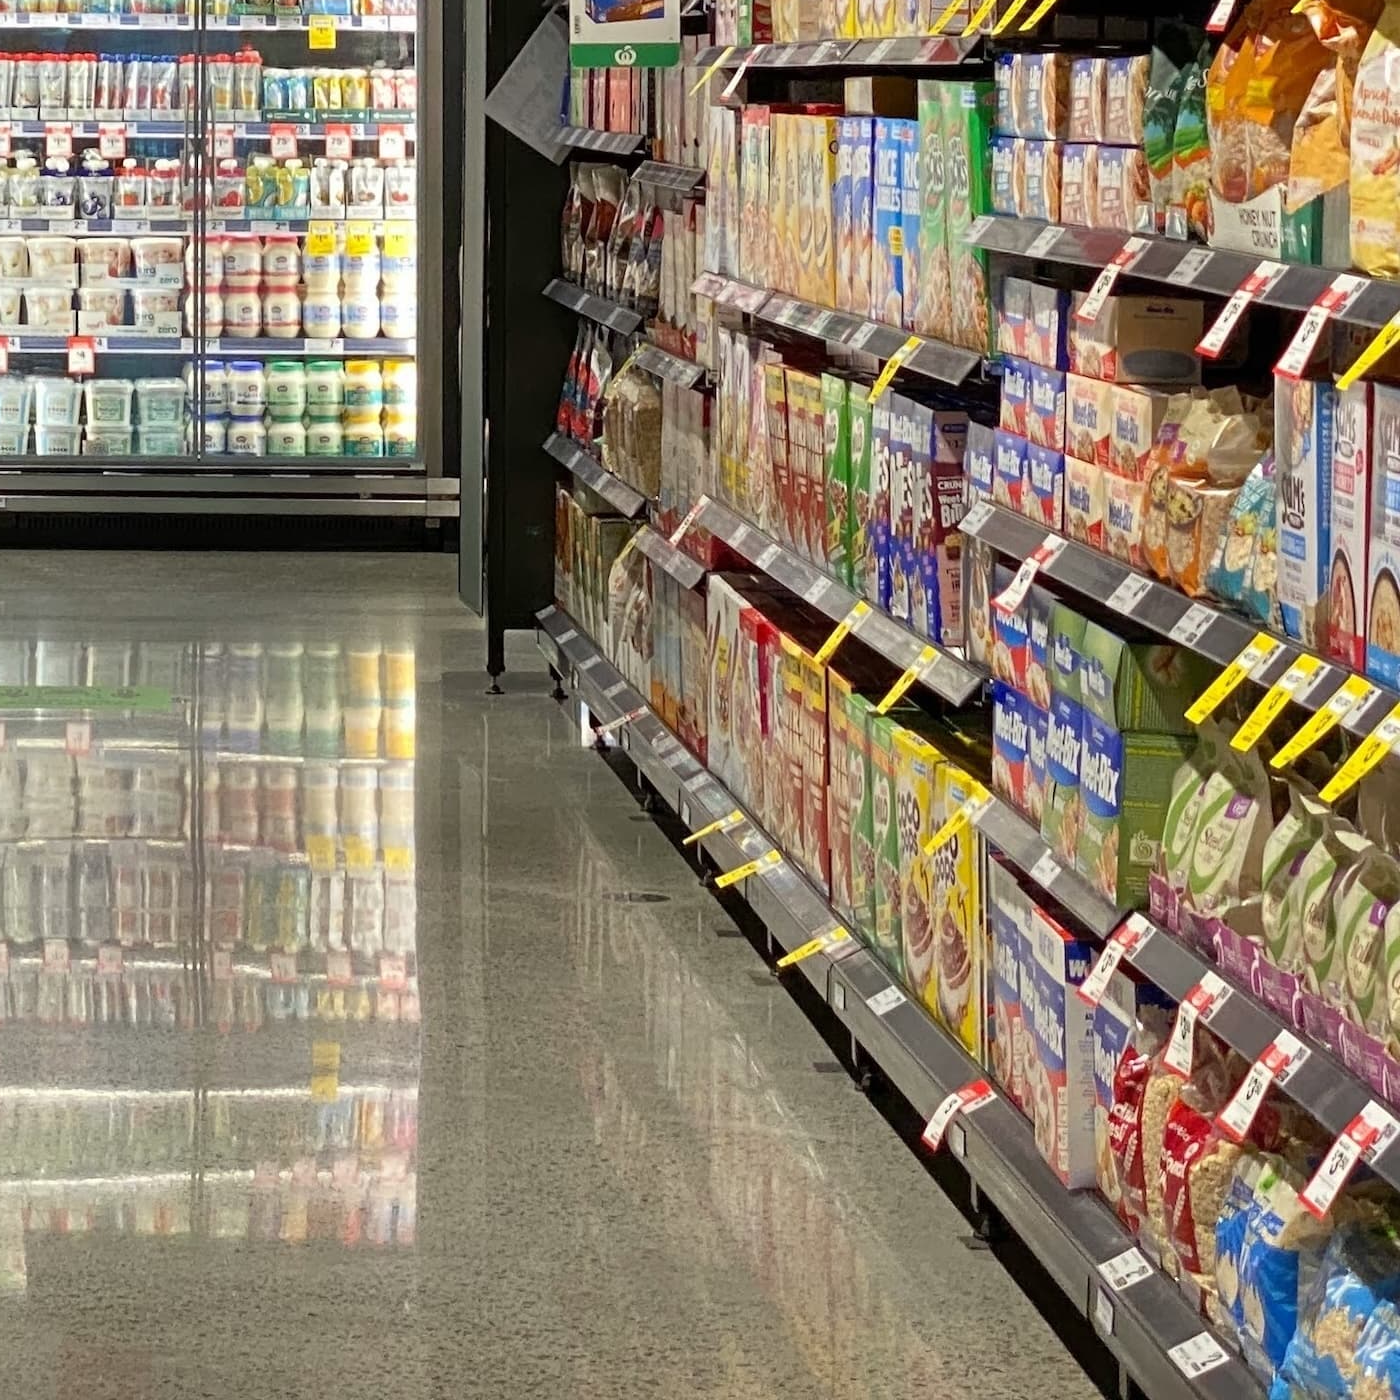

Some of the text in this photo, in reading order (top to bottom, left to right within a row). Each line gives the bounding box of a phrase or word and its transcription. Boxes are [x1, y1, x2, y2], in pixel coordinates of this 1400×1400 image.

[904, 151, 920, 189] RIC
[937, 479, 963, 490] CRUN
[941, 503, 963, 528] BiT
